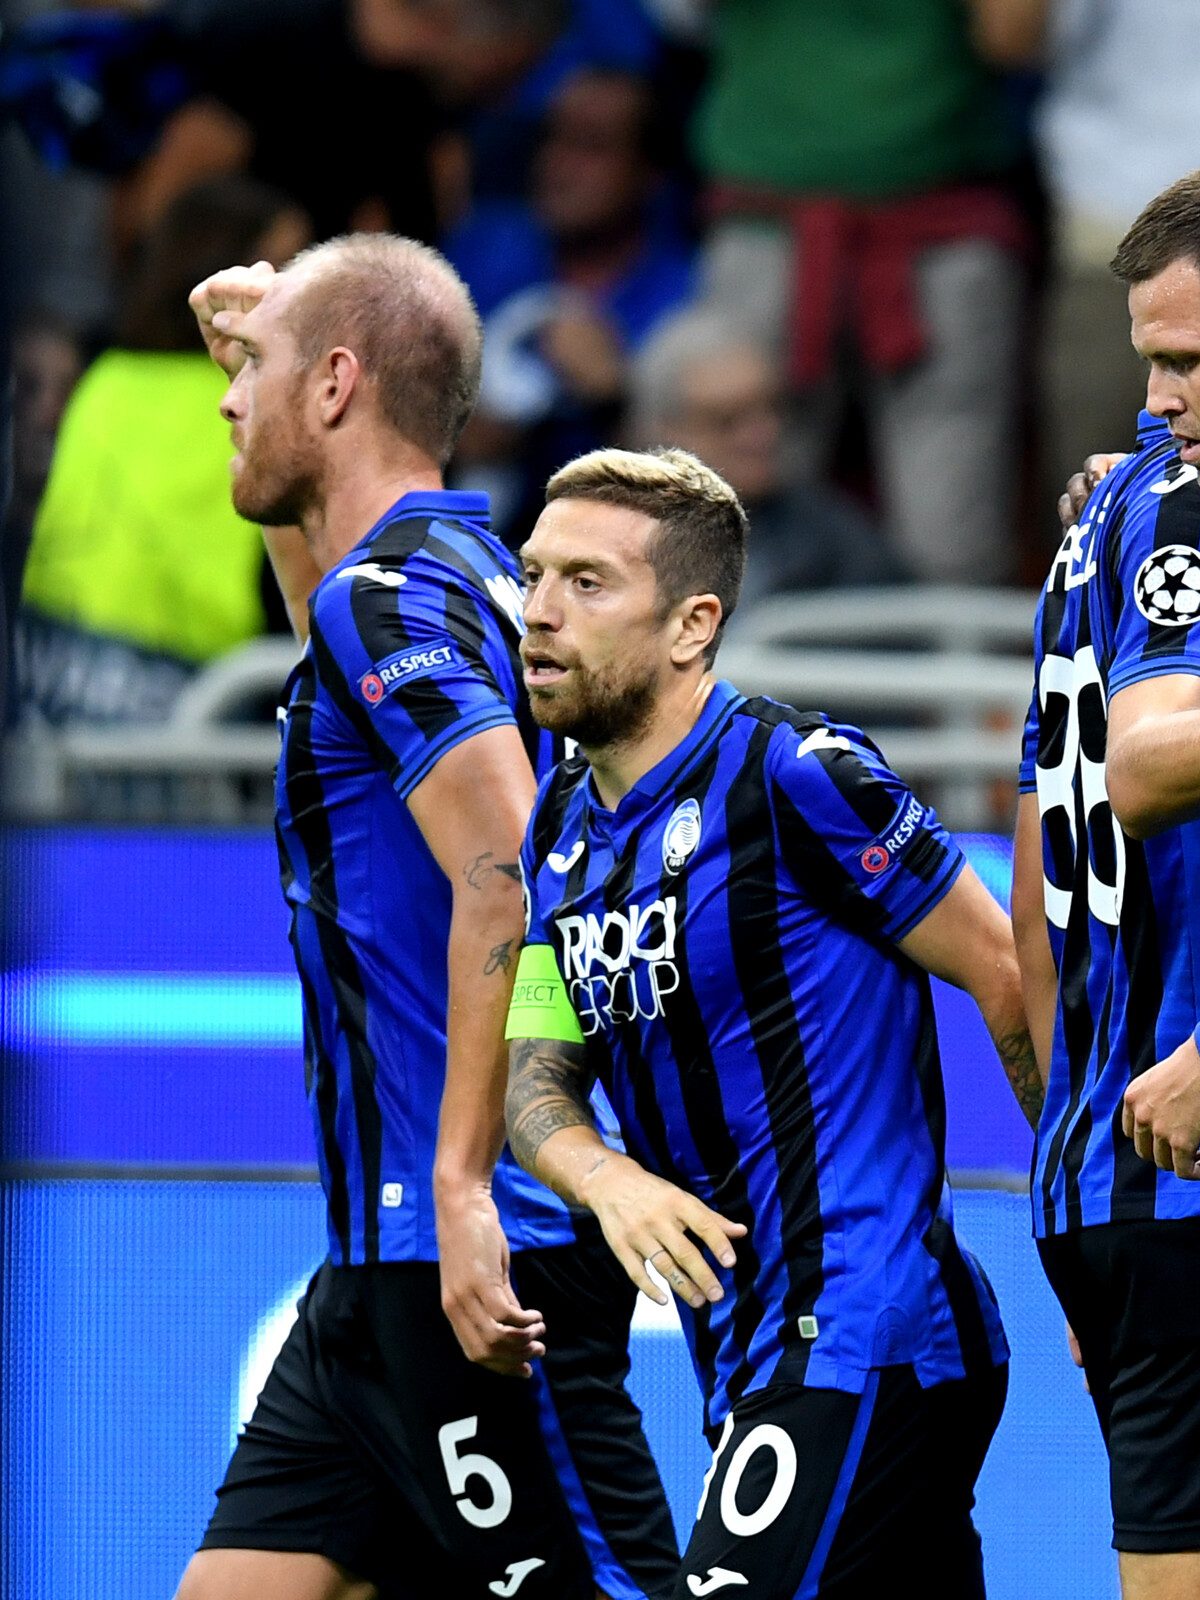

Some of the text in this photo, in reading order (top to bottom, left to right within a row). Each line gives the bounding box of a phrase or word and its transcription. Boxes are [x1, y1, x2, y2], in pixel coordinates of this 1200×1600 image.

[379, 646, 452, 685] RESPECT
[555, 896, 677, 979] RADICI
[570, 960, 680, 1036] GROUP
[438, 1415, 512, 1529] 5
